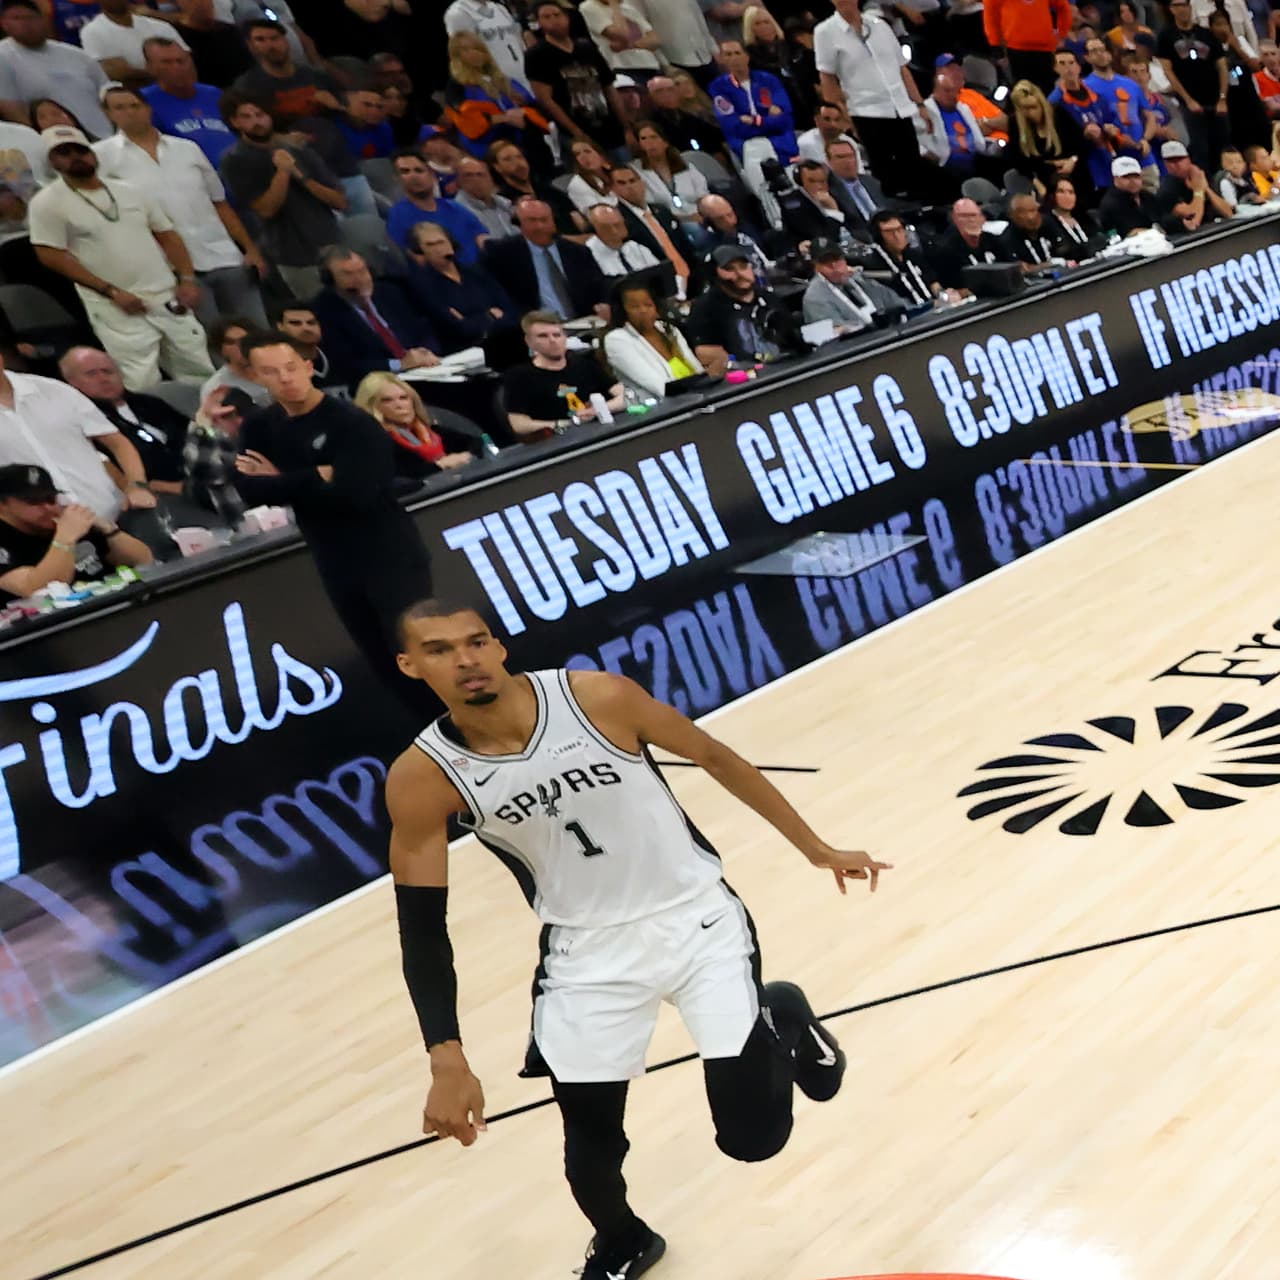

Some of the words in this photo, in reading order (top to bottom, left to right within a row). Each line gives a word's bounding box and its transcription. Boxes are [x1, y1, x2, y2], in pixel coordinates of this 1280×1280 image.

[442, 442, 730, 636] TUESDAY
[734, 385, 895, 525] GAME
[876, 374, 927, 470] 6
[928, 327, 1083, 449] 8:30PM
[1066, 312, 1119, 396] ET
[1129, 287, 1172, 370] IF
[494, 763, 622, 825] SPURS
[565, 821, 606, 857] 1
